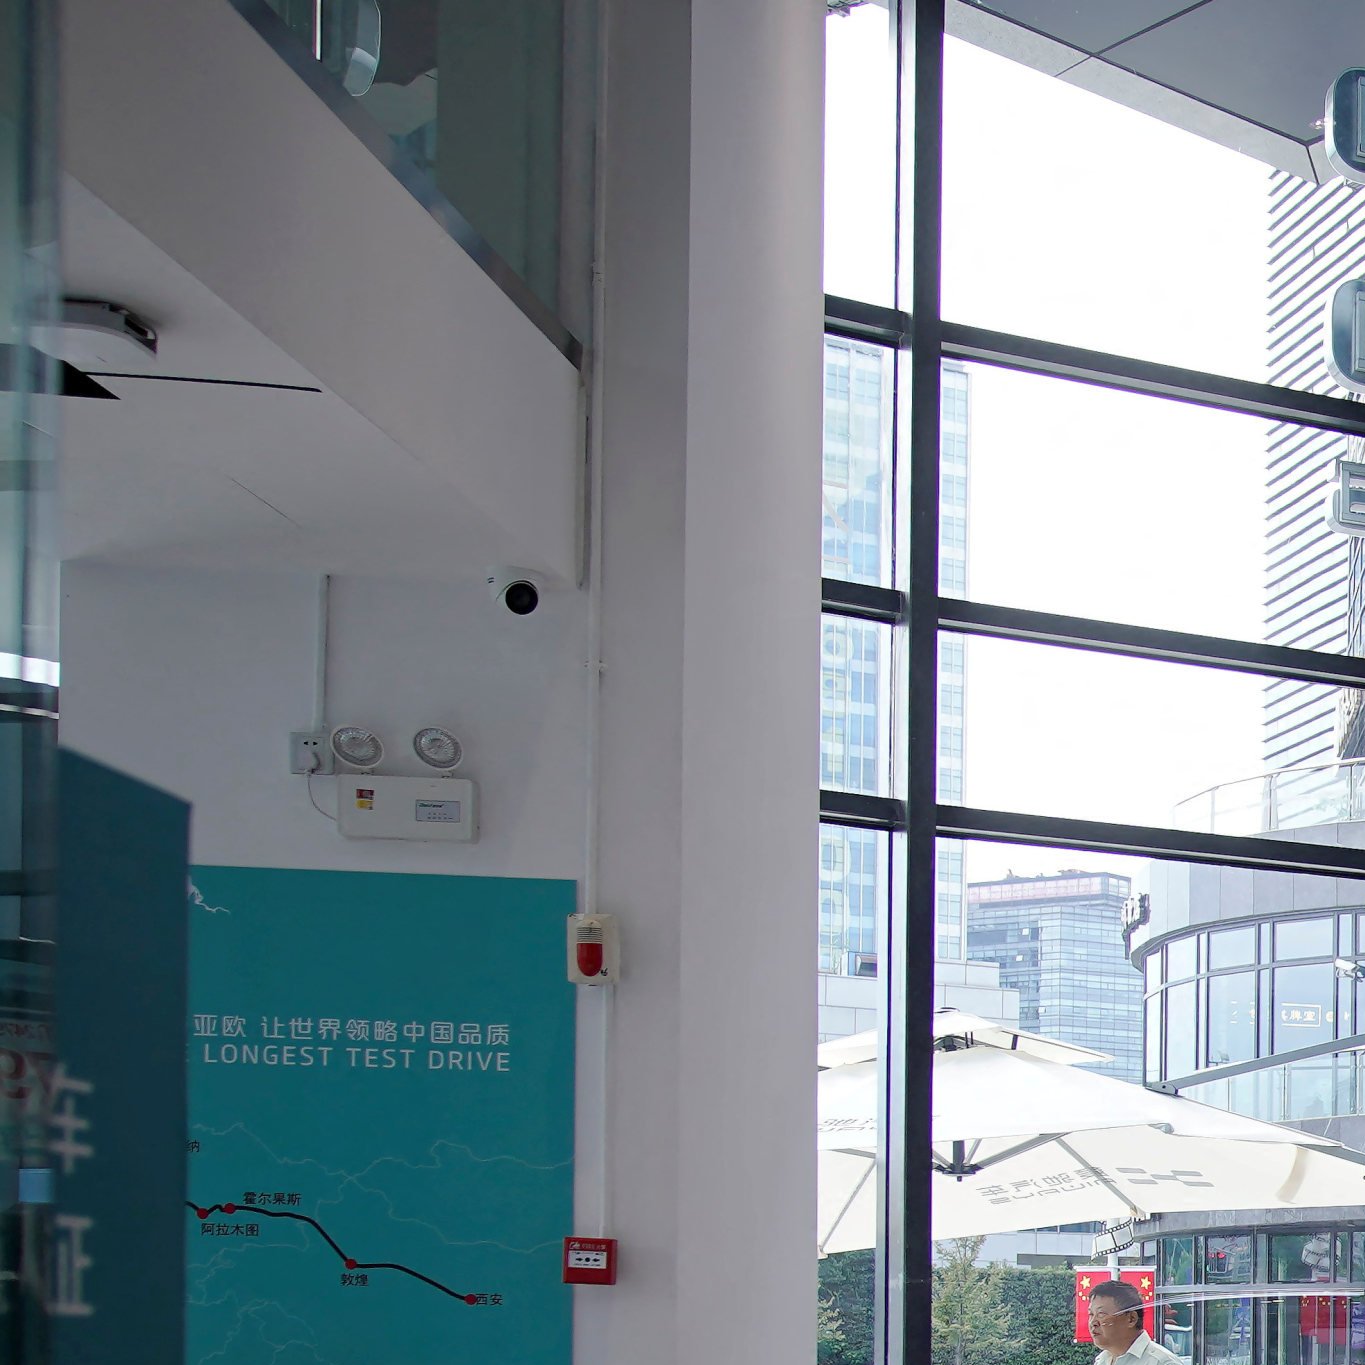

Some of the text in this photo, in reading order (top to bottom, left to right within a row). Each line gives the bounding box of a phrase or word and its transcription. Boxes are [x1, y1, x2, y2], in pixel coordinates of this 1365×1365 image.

[193, 1014, 511, 1047] 亚欧 让世界领略中国品质
[202, 1043, 511, 1073] LONGEST TEST DRIVE
[243, 1191, 302, 1207] 霍尔果斯
[201, 1222, 260, 1238] 阿拉木图
[340, 1273, 369, 1288] 敦煌
[475, 1293, 503, 1307] 西安
